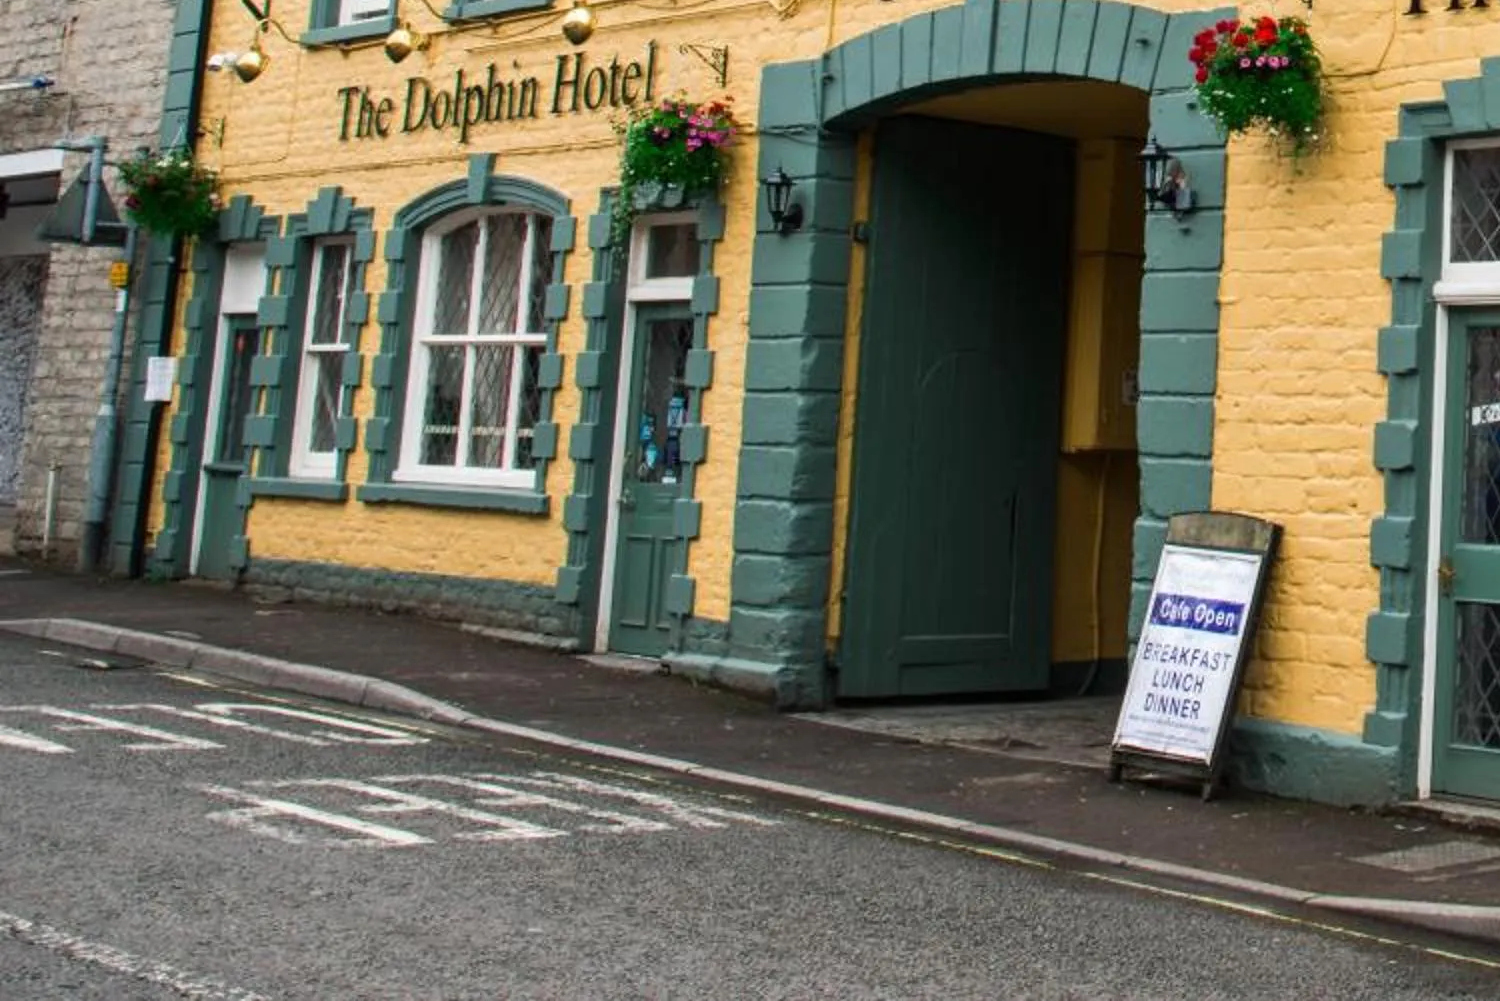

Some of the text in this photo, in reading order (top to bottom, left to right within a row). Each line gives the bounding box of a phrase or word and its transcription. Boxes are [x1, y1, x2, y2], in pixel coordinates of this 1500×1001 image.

[338, 38, 657, 143] The Dolphin Hotel
[1194, 603, 1236, 628] Open
[1142, 642, 1232, 671] BREAKFAST
[1152, 668, 1204, 694] LUNCH
[1143, 692, 1201, 719] DINNER
